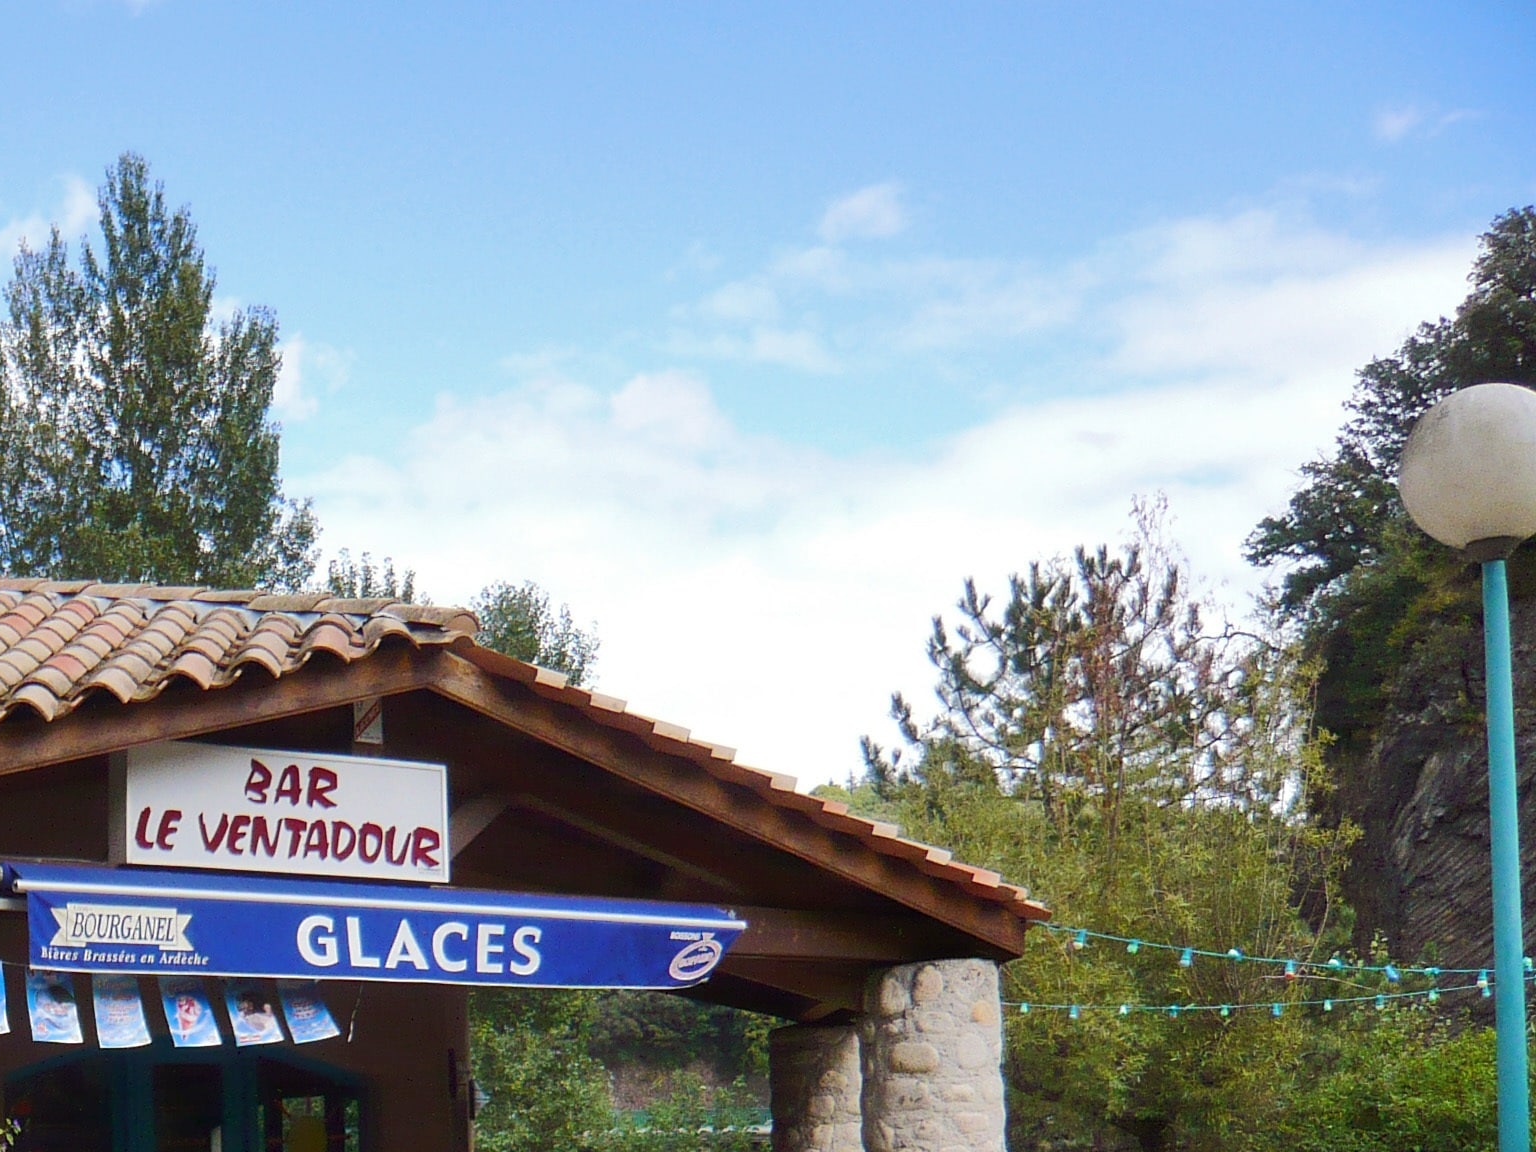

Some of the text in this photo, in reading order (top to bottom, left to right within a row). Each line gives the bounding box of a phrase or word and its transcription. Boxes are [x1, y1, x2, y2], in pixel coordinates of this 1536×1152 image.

[244, 757, 338, 809] BAR
[135, 806, 441, 868] LE VENTADOUR
[71, 911, 175, 942] BOURGANEL
[296, 914, 542, 976] GLACES
[40, 945, 210, 966] Bières Brassées en Ardèche
